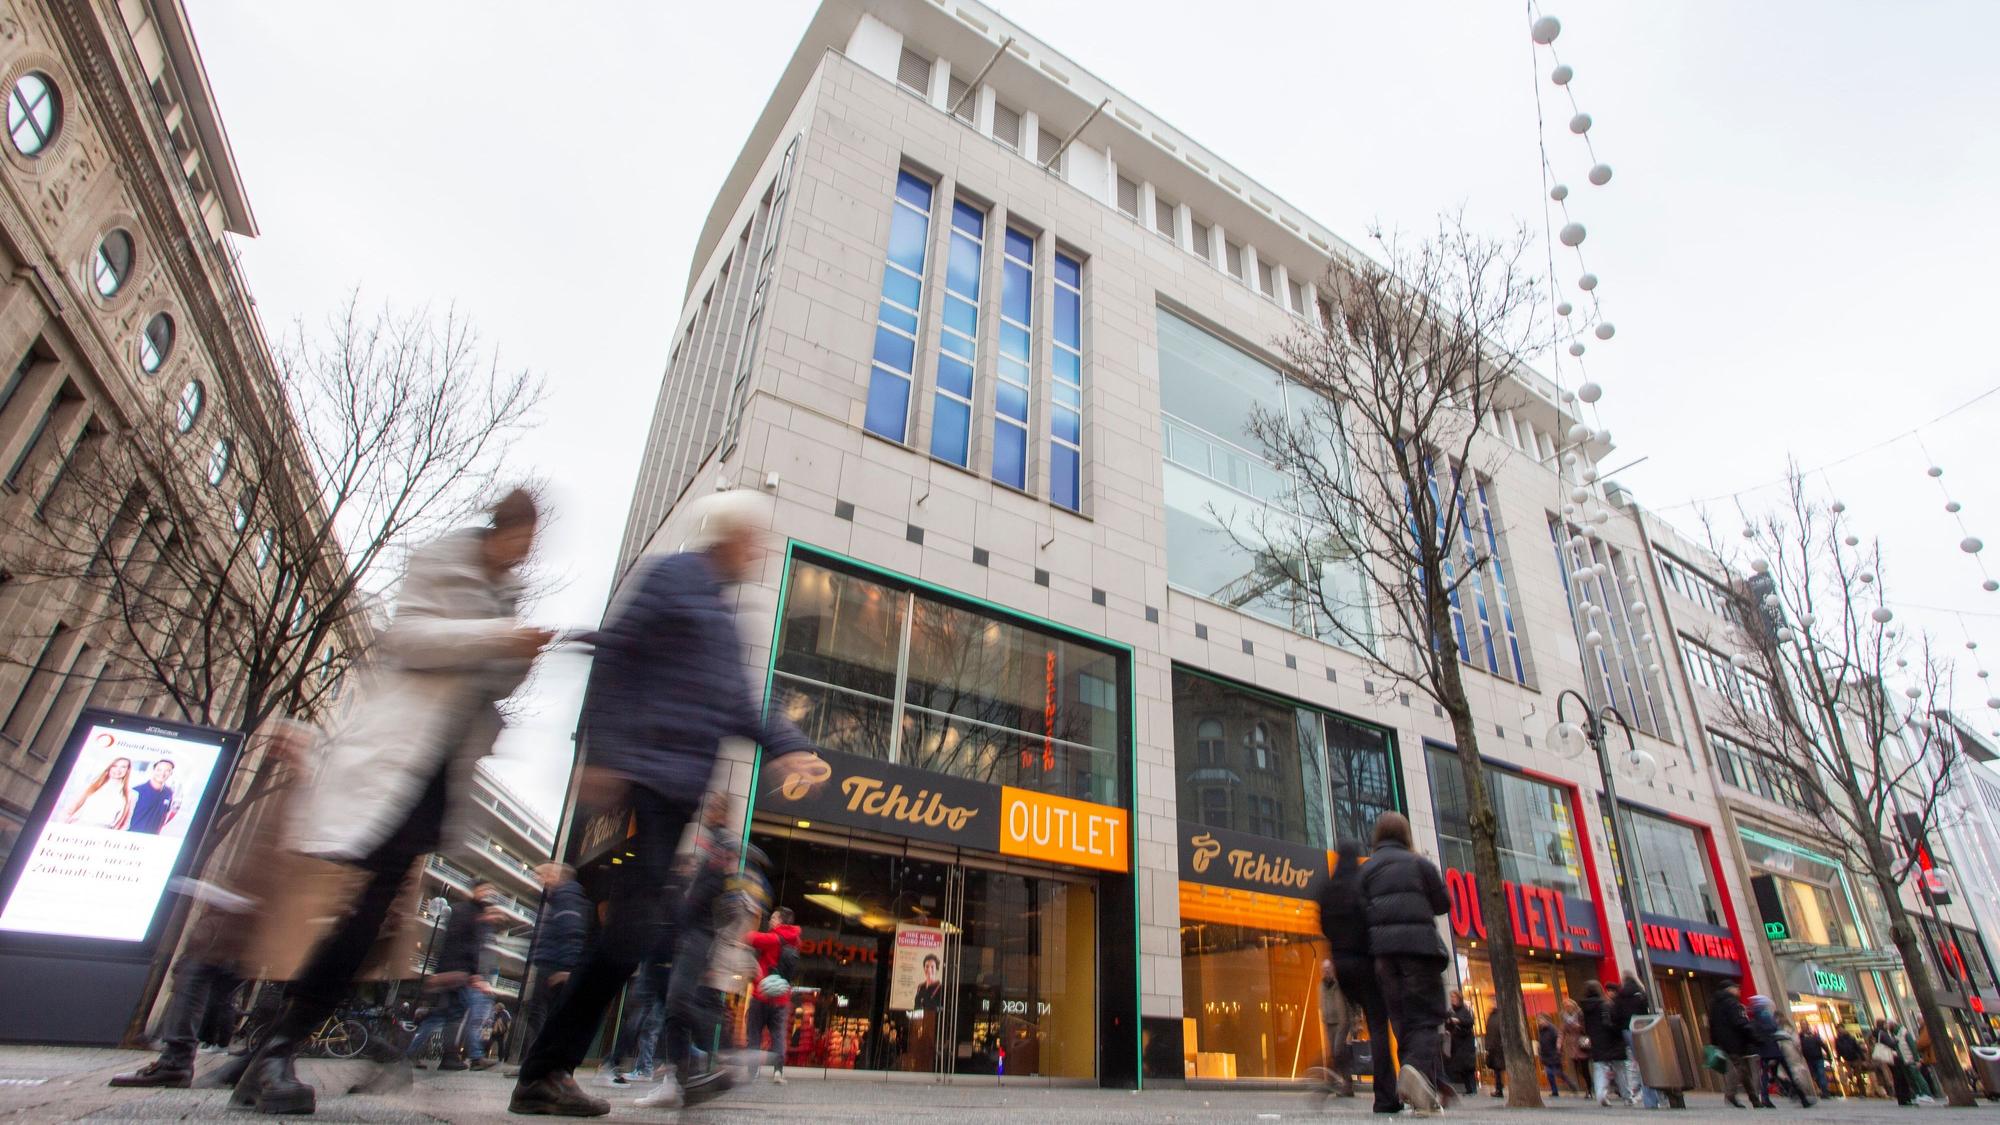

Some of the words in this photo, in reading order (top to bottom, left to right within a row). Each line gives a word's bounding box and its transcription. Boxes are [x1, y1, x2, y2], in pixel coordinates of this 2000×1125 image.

[841, 775, 979, 832] Tchibo
[1008, 800, 1120, 857] OUTLET
[1228, 849, 1315, 889] Tchibo
[1445, 867, 1574, 953] OULET!
[1814, 970, 1847, 993] DOUGLAS
